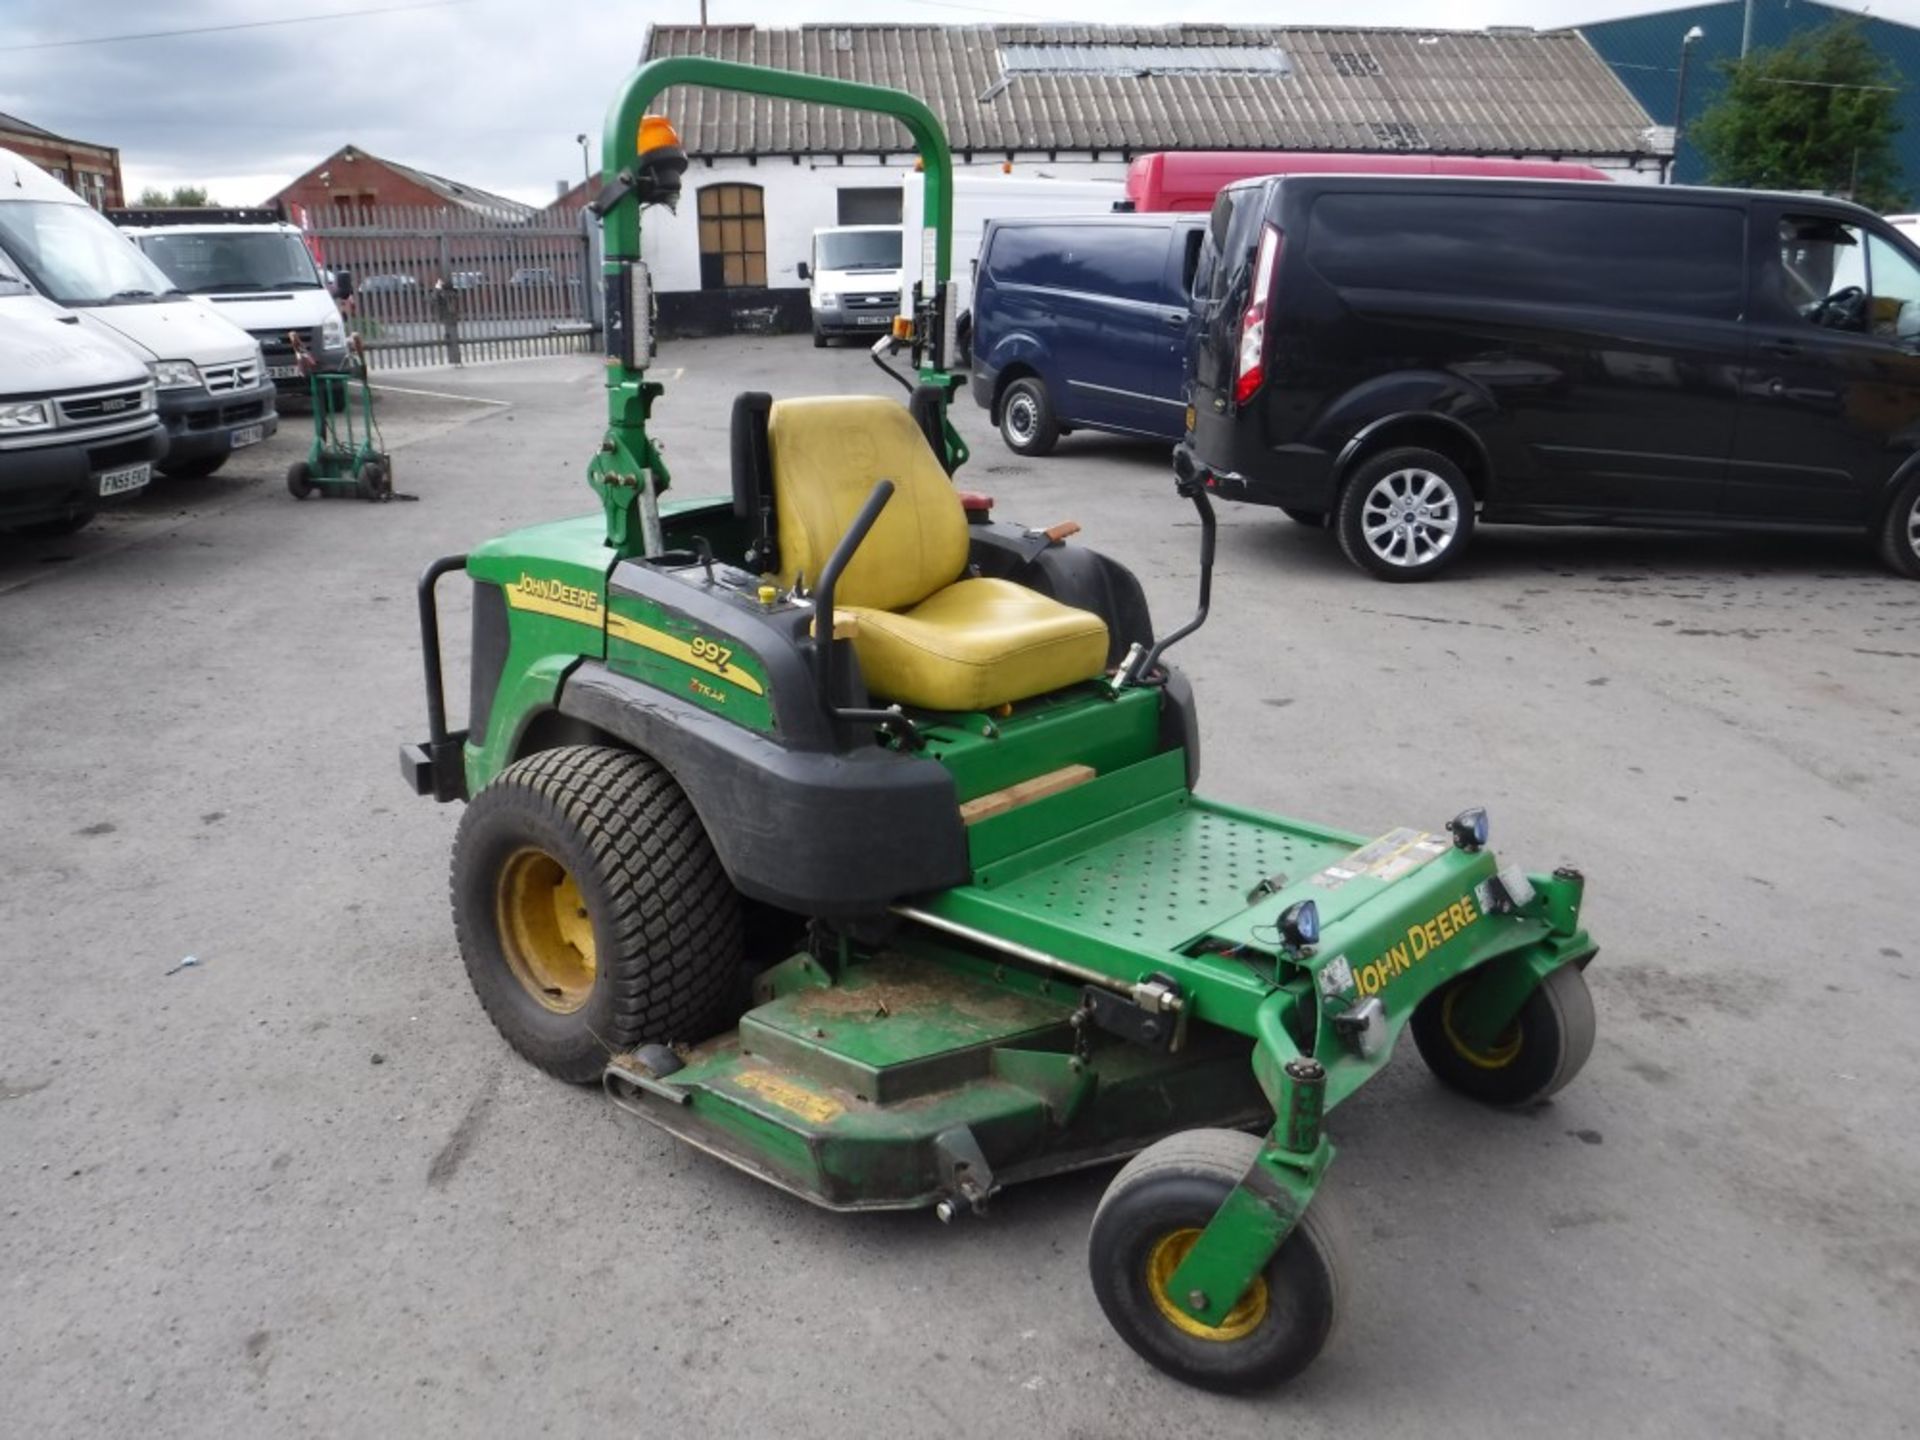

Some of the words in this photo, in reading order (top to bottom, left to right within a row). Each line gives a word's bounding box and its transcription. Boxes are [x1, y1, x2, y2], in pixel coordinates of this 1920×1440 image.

[516, 571, 550, 598] JOHN
[550, 579, 598, 611] DEERE
[692, 636, 732, 666] 997
[1407, 895, 1477, 960] DEERE
